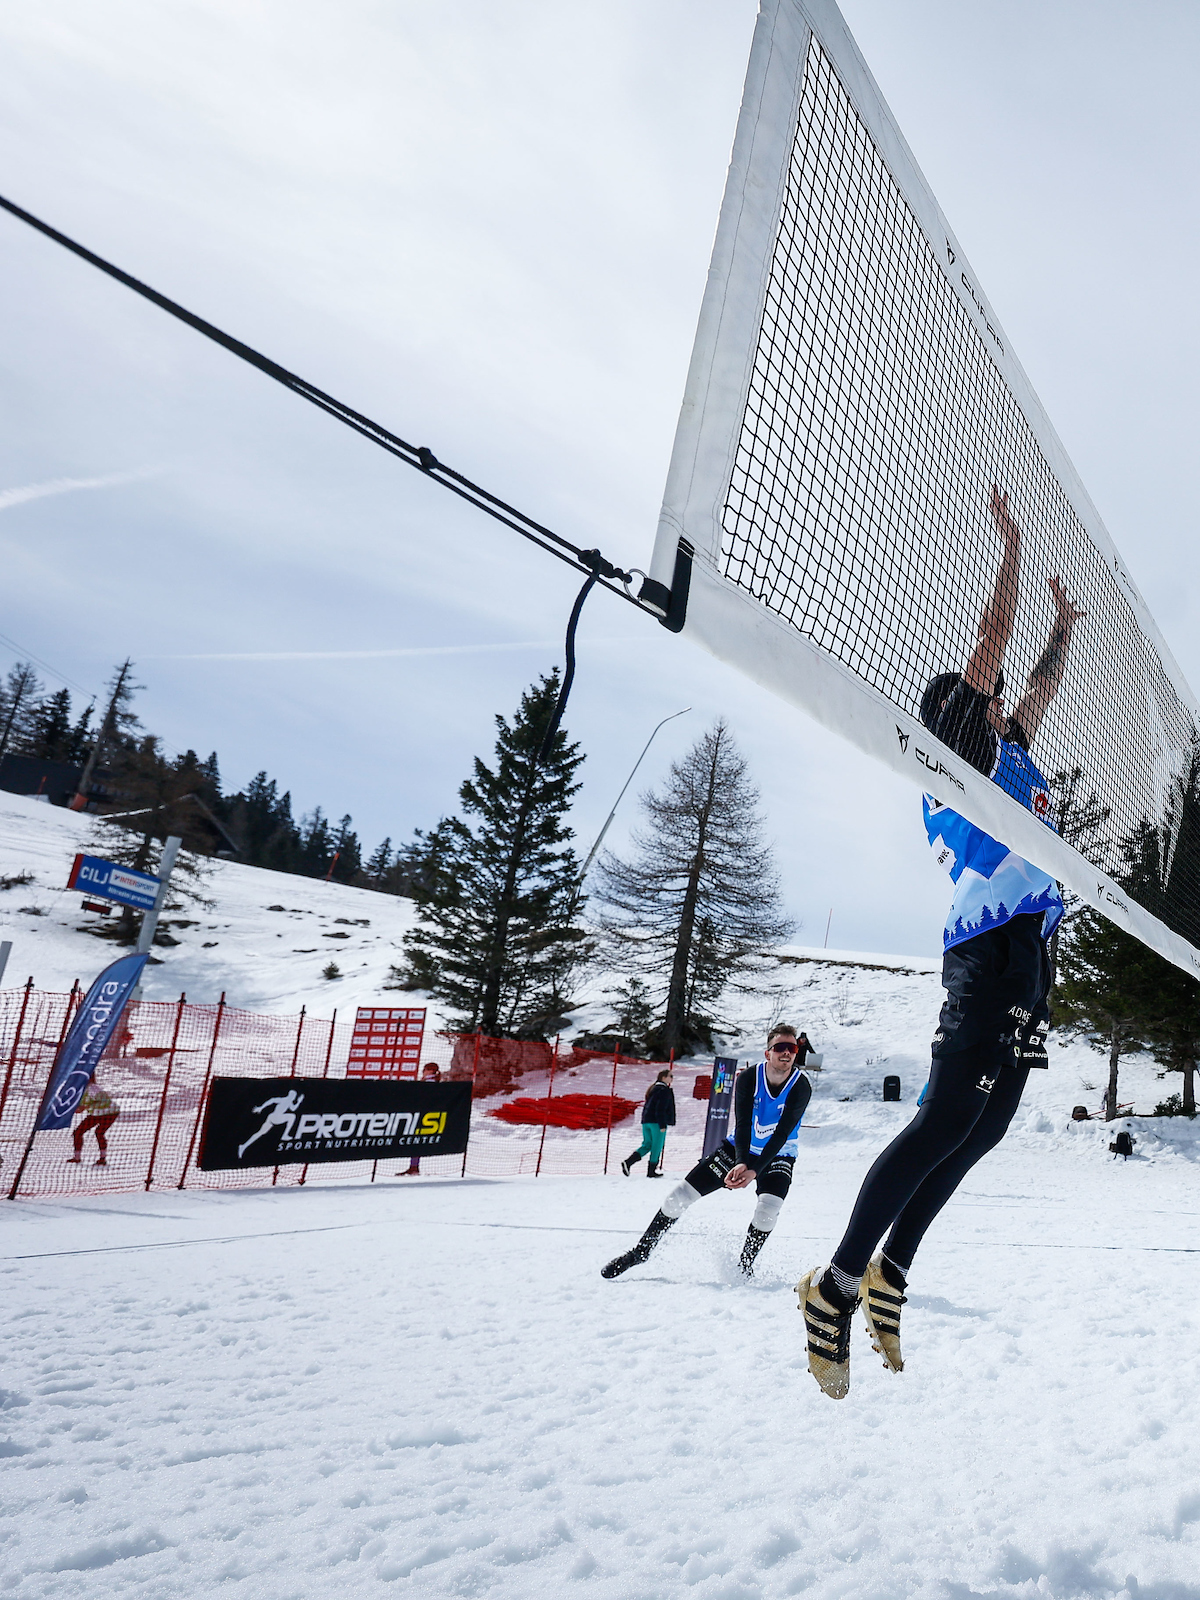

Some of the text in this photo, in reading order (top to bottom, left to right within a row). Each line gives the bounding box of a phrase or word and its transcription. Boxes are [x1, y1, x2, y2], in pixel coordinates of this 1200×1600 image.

[915, 746, 966, 796] CUPRA
[80, 866, 109, 885] CILJ
[277, 1140, 321, 1152] SPORT
[325, 1137, 393, 1149] NUTRITION
